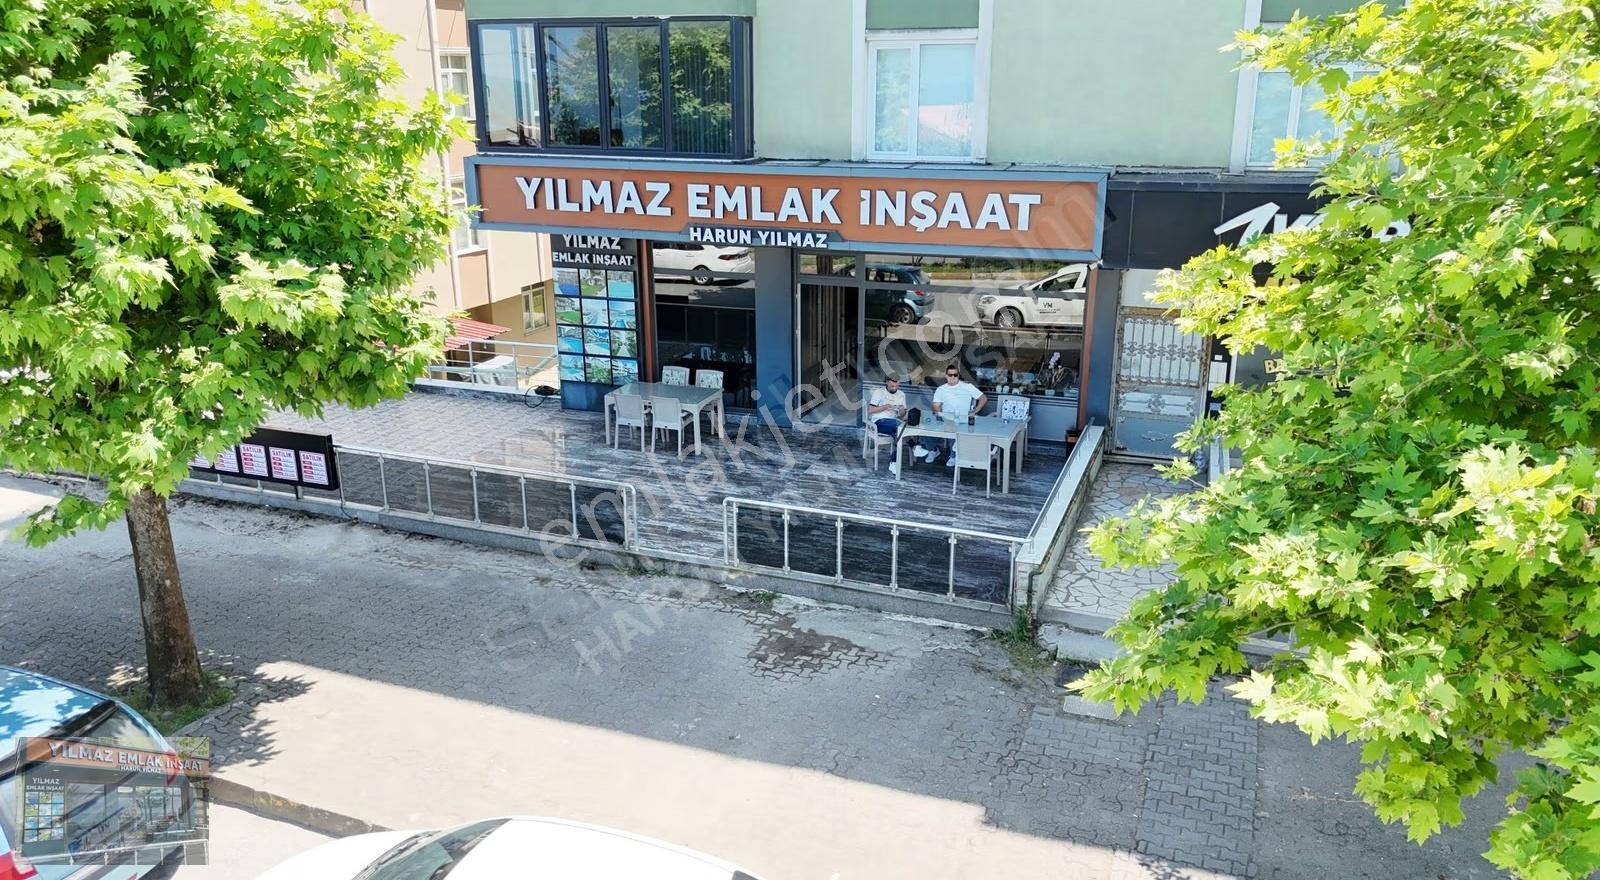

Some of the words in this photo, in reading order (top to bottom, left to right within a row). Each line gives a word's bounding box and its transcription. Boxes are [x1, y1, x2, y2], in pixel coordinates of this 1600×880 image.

[515, 176, 672, 217] YILMAZ
[686, 184, 842, 224] EMLAK
[859, 189, 1042, 232] İNŞAAT
[562, 234, 621, 250] YILMAZ
[689, 227, 751, 244] HARUN
[757, 230, 828, 248] YILMAZ
[552, 251, 590, 264] EMLAK
[242, 446, 262, 454] SATILIK
[272, 450, 292, 458] SATILIK
[302, 454, 323, 462] SATILIK
